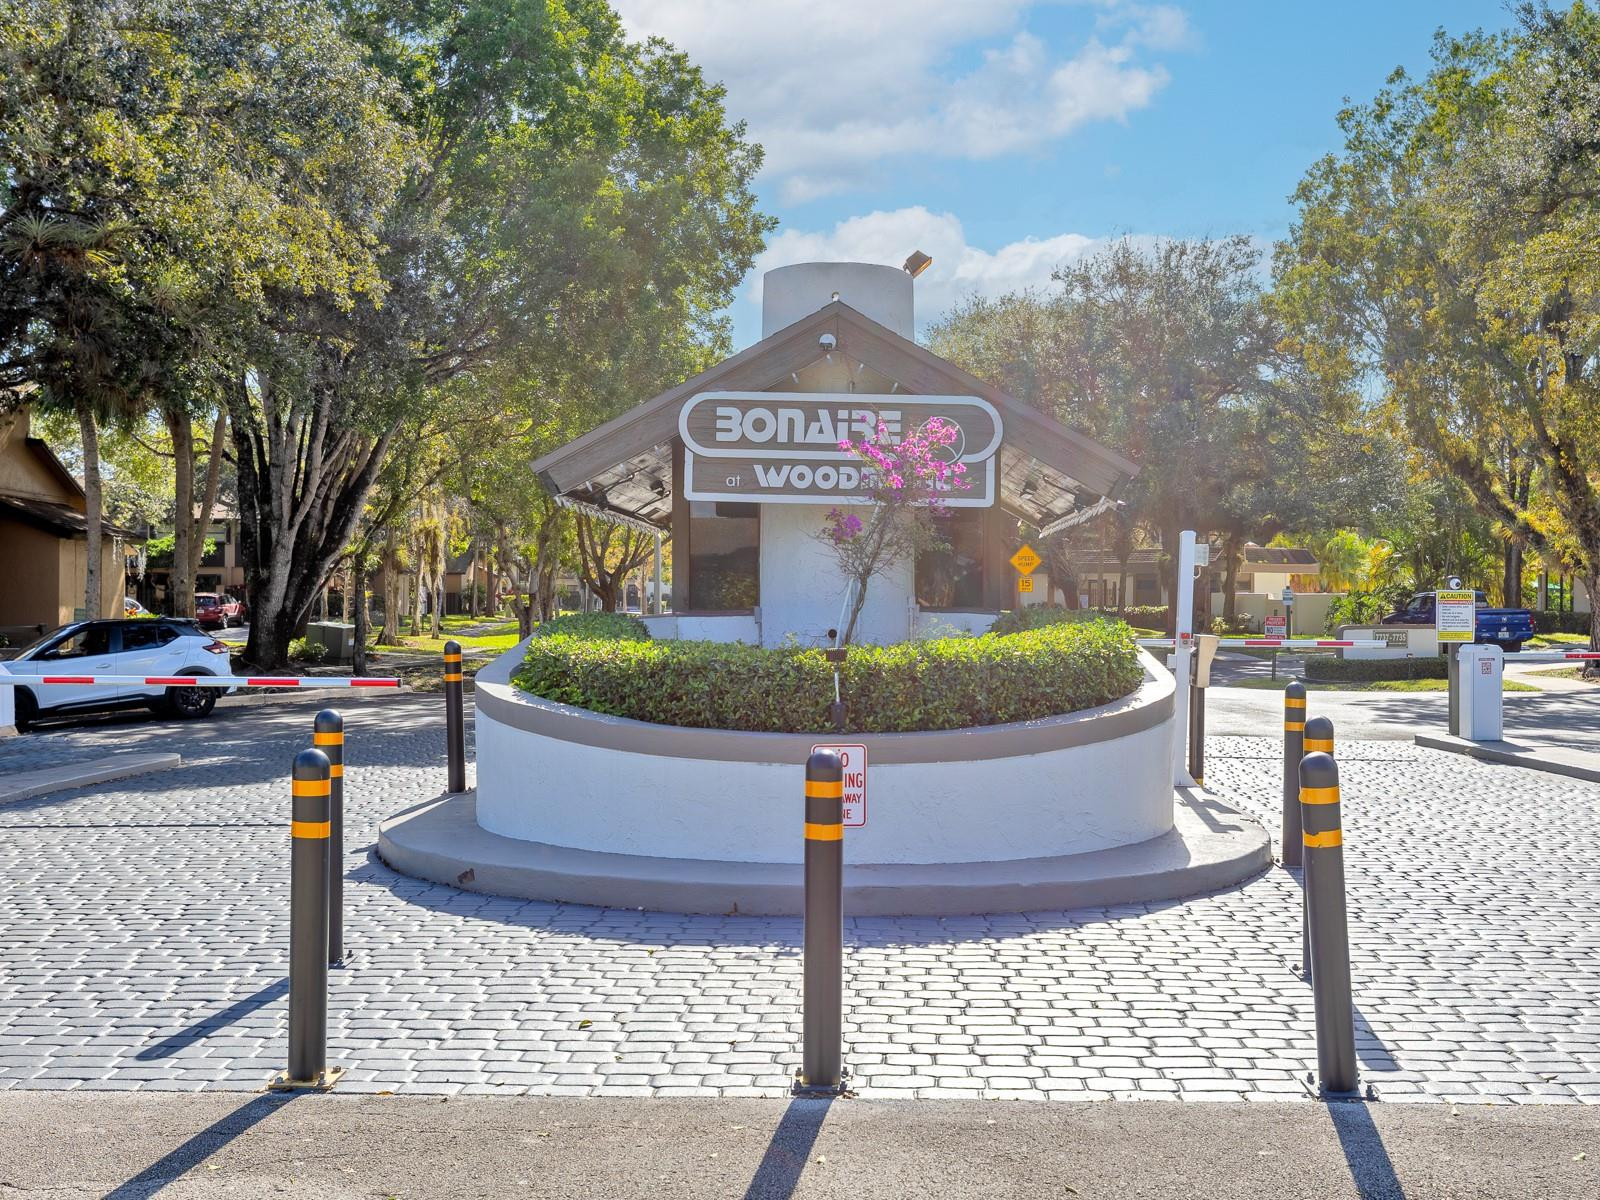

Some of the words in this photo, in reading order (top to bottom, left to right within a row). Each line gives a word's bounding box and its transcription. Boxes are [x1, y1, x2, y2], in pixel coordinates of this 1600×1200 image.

[716, 406, 902, 444] BONAIRE
[726, 475, 741, 487] at
[753, 464, 952, 491] WOOD
[841, 752, 849, 768] O
